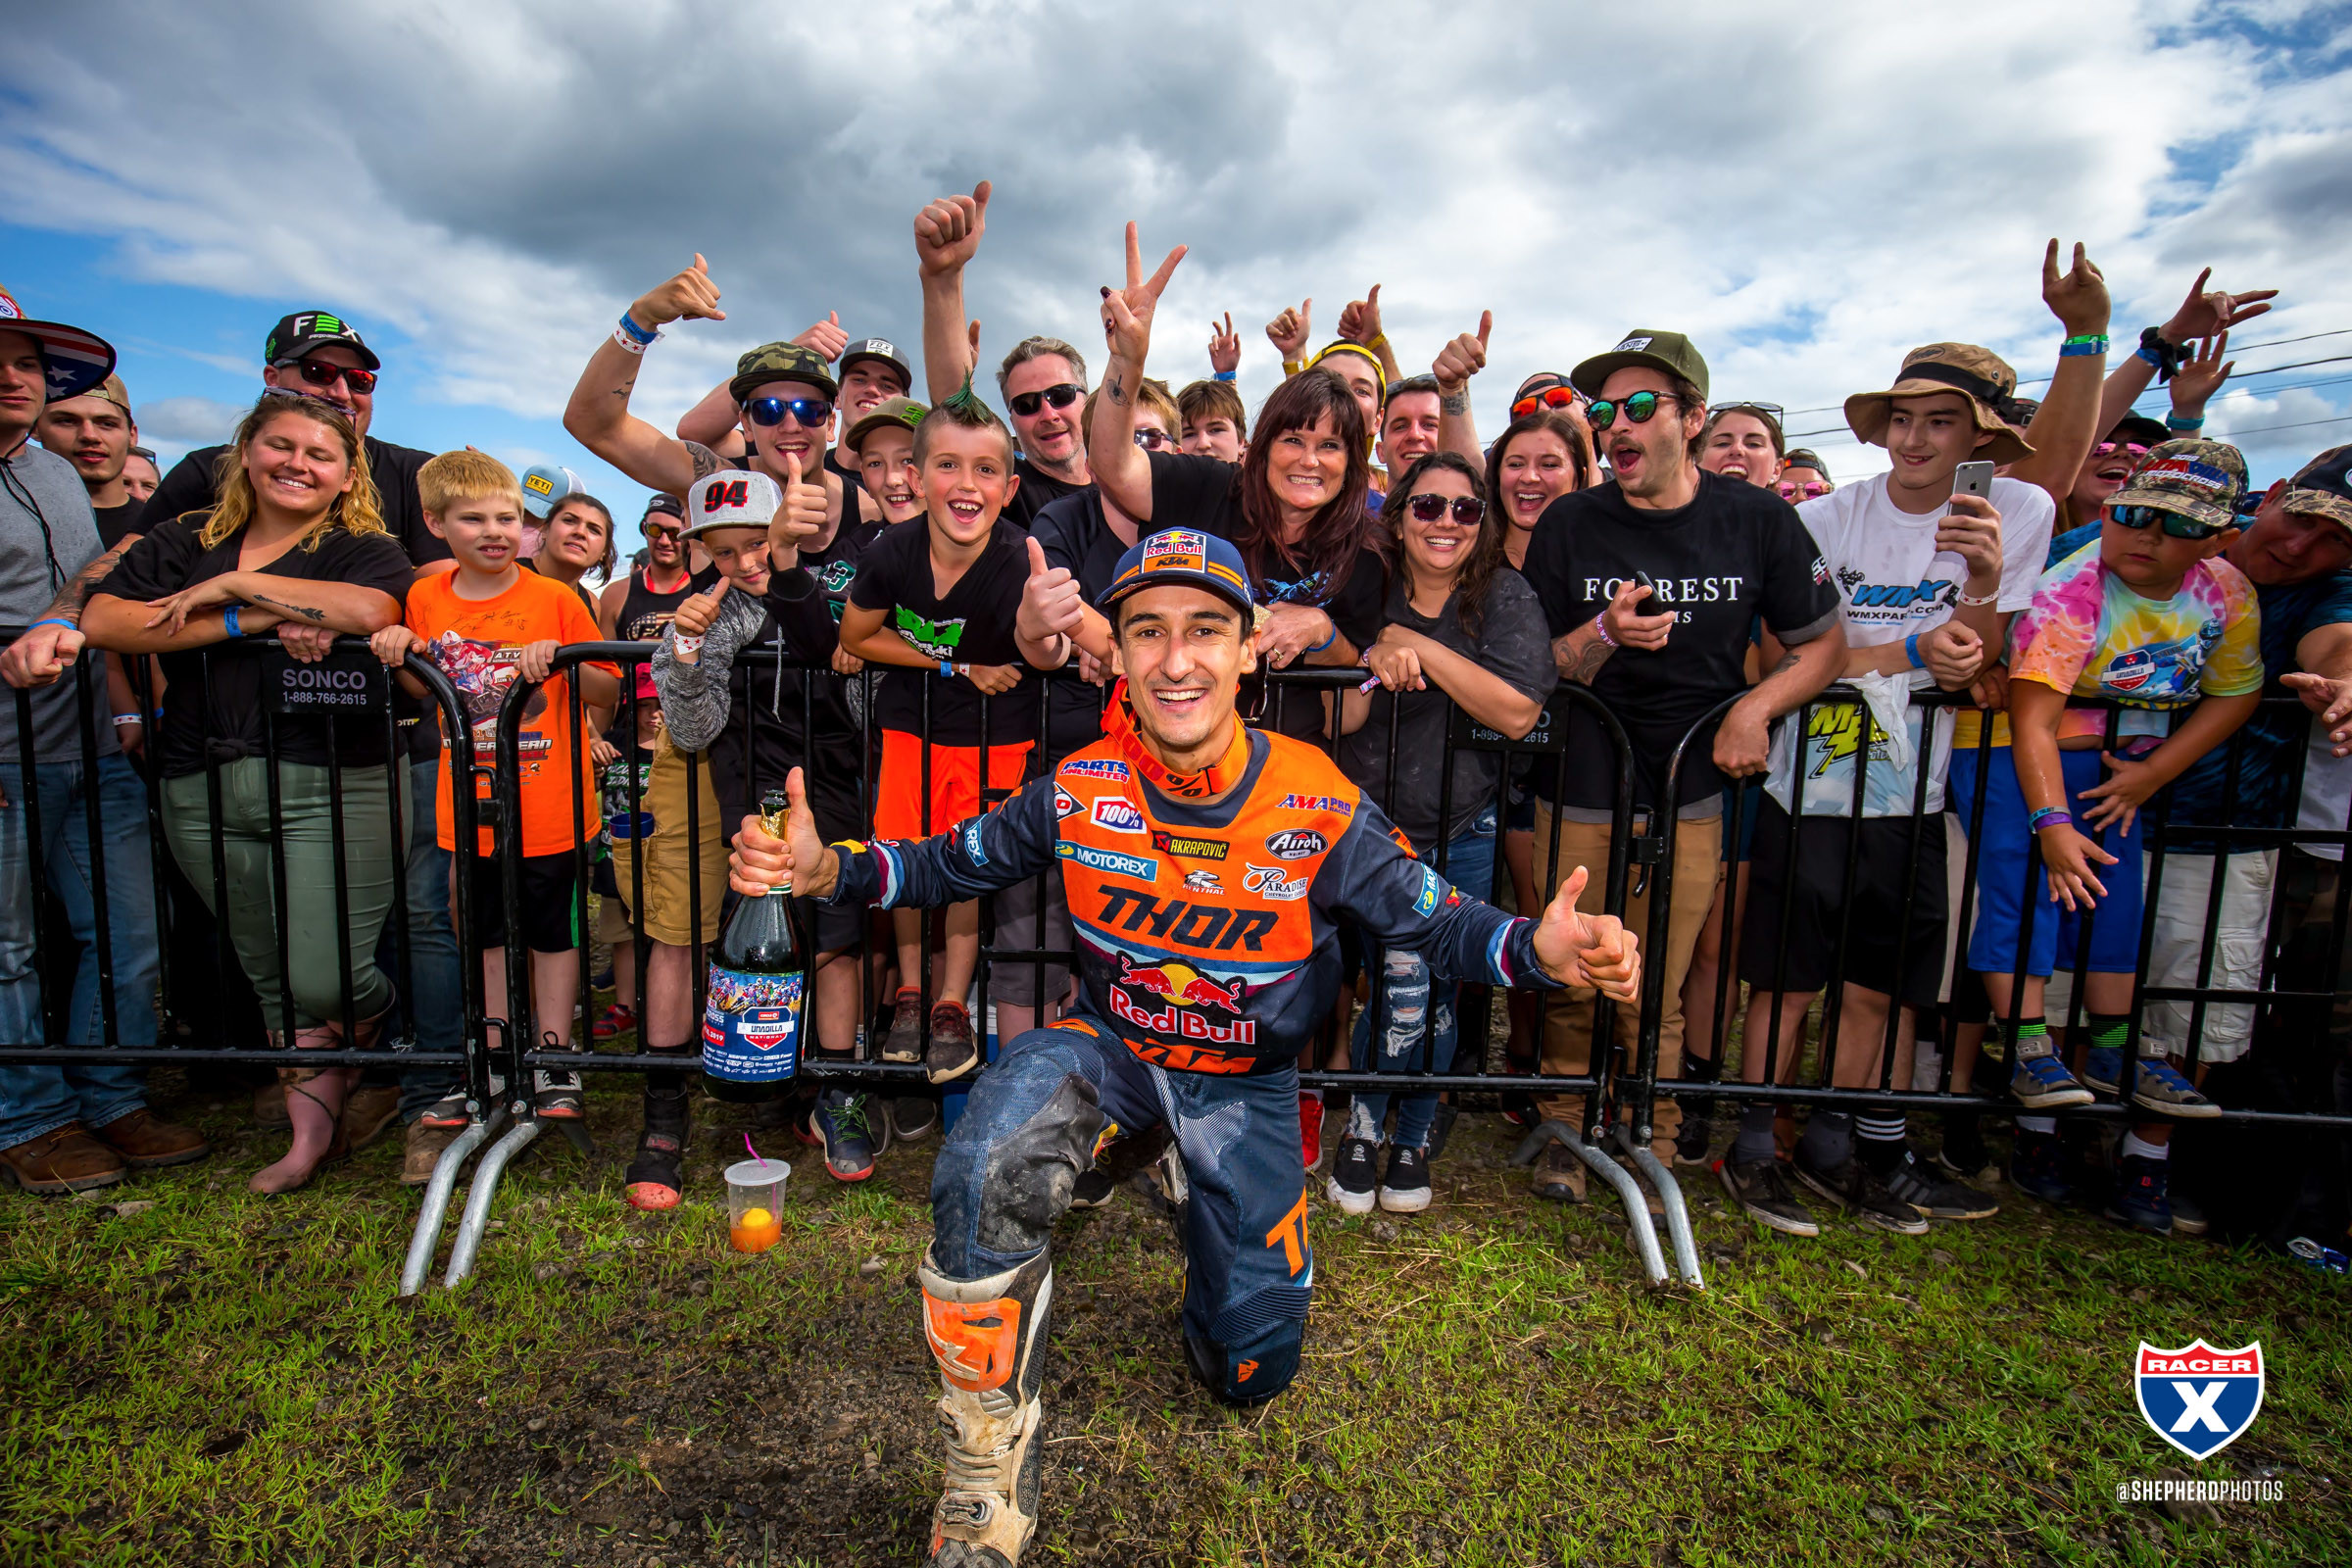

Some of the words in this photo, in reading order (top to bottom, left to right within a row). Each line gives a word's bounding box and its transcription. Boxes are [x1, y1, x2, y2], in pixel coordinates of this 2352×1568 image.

[529, 476, 551, 490] YETI
[2144, 470, 2223, 489] MOTOCROSS
[704, 479, 749, 514] 94
[1146, 543, 1173, 558] Red
[1175, 542, 1202, 556] Bull
[1155, 556, 1190, 567] KTM
[1583, 576, 1743, 603] FOREST
[1850, 579, 1953, 609] WMX
[282, 668, 368, 690] SONCO
[282, 691, 368, 706] 1-888-766-2615
[1059, 768, 1130, 784] UNLIMITED
[1062, 760, 1130, 776] PARTS
[1275, 793, 1329, 810] AMA
[1330, 797, 1351, 811] PRO
[1099, 804, 1141, 828] 100%
[1329, 807, 1351, 817] RACING
[1270, 833, 1322, 851] Airoh
[1077, 847, 1149, 876] MOTOREX
[1182, 883, 1225, 896] RENTHAL
[1097, 884, 1279, 952] THOR
[1109, 983, 1178, 1035] Red
[1180, 1010, 1256, 1045] Bull
[751, 1024, 783, 1033] UNADILLA
[1122, 1037, 1257, 1074] KTM
